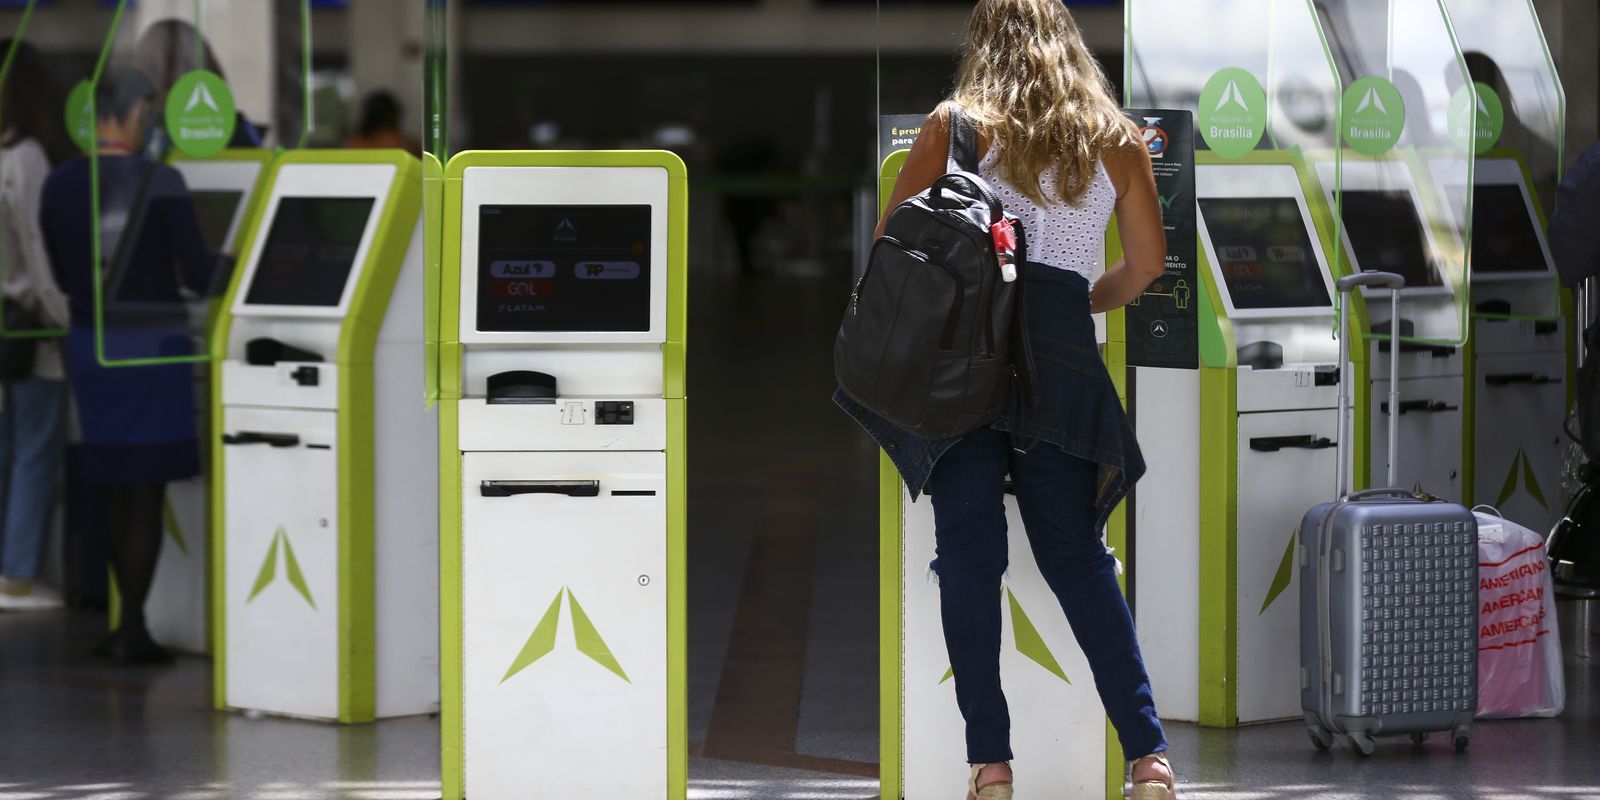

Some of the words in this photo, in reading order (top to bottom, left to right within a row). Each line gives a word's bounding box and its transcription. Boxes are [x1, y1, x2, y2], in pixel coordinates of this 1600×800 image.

[891, 127, 897, 135] É
[1210, 125, 1253, 138] Brasília
[892, 138, 913, 146] para
[507, 282, 536, 296] GOL
[507, 304, 545, 312] LATAM
